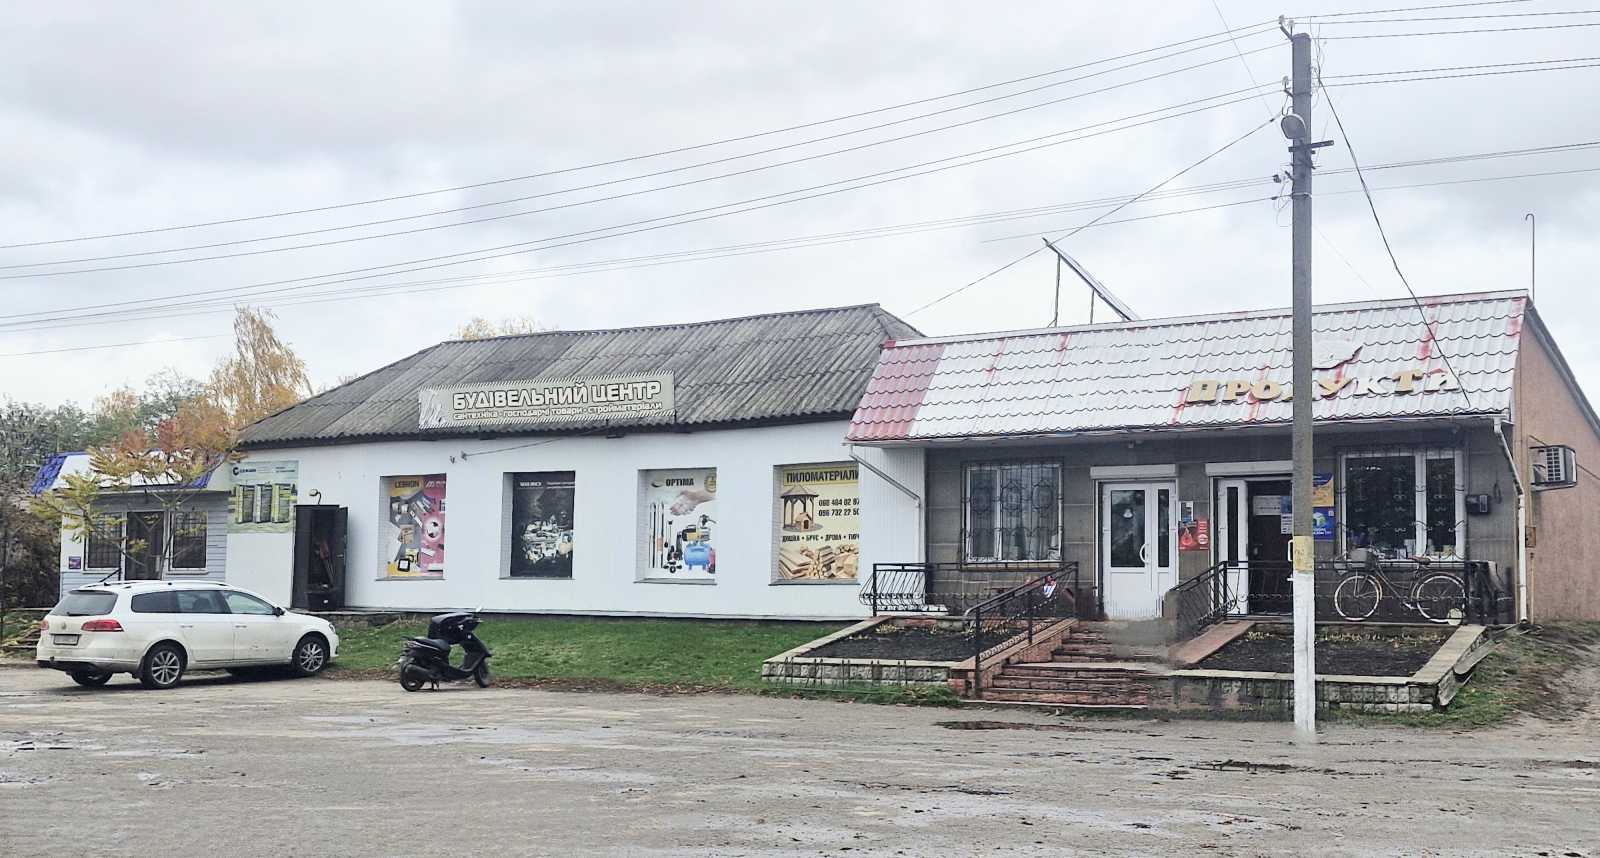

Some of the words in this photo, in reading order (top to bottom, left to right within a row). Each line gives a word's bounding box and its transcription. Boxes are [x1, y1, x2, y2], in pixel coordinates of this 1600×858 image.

[453, 381, 588, 410] БУДІВЕЛЬНИЙ
[591, 381, 662, 403] ЦЕНТР
[1188, 370, 1460, 404] ПРОУКТИ
[453, 411, 498, 420] сантехніка
[551, 406, 583, 416] товари
[665, 478, 694, 487] OPTIMA
